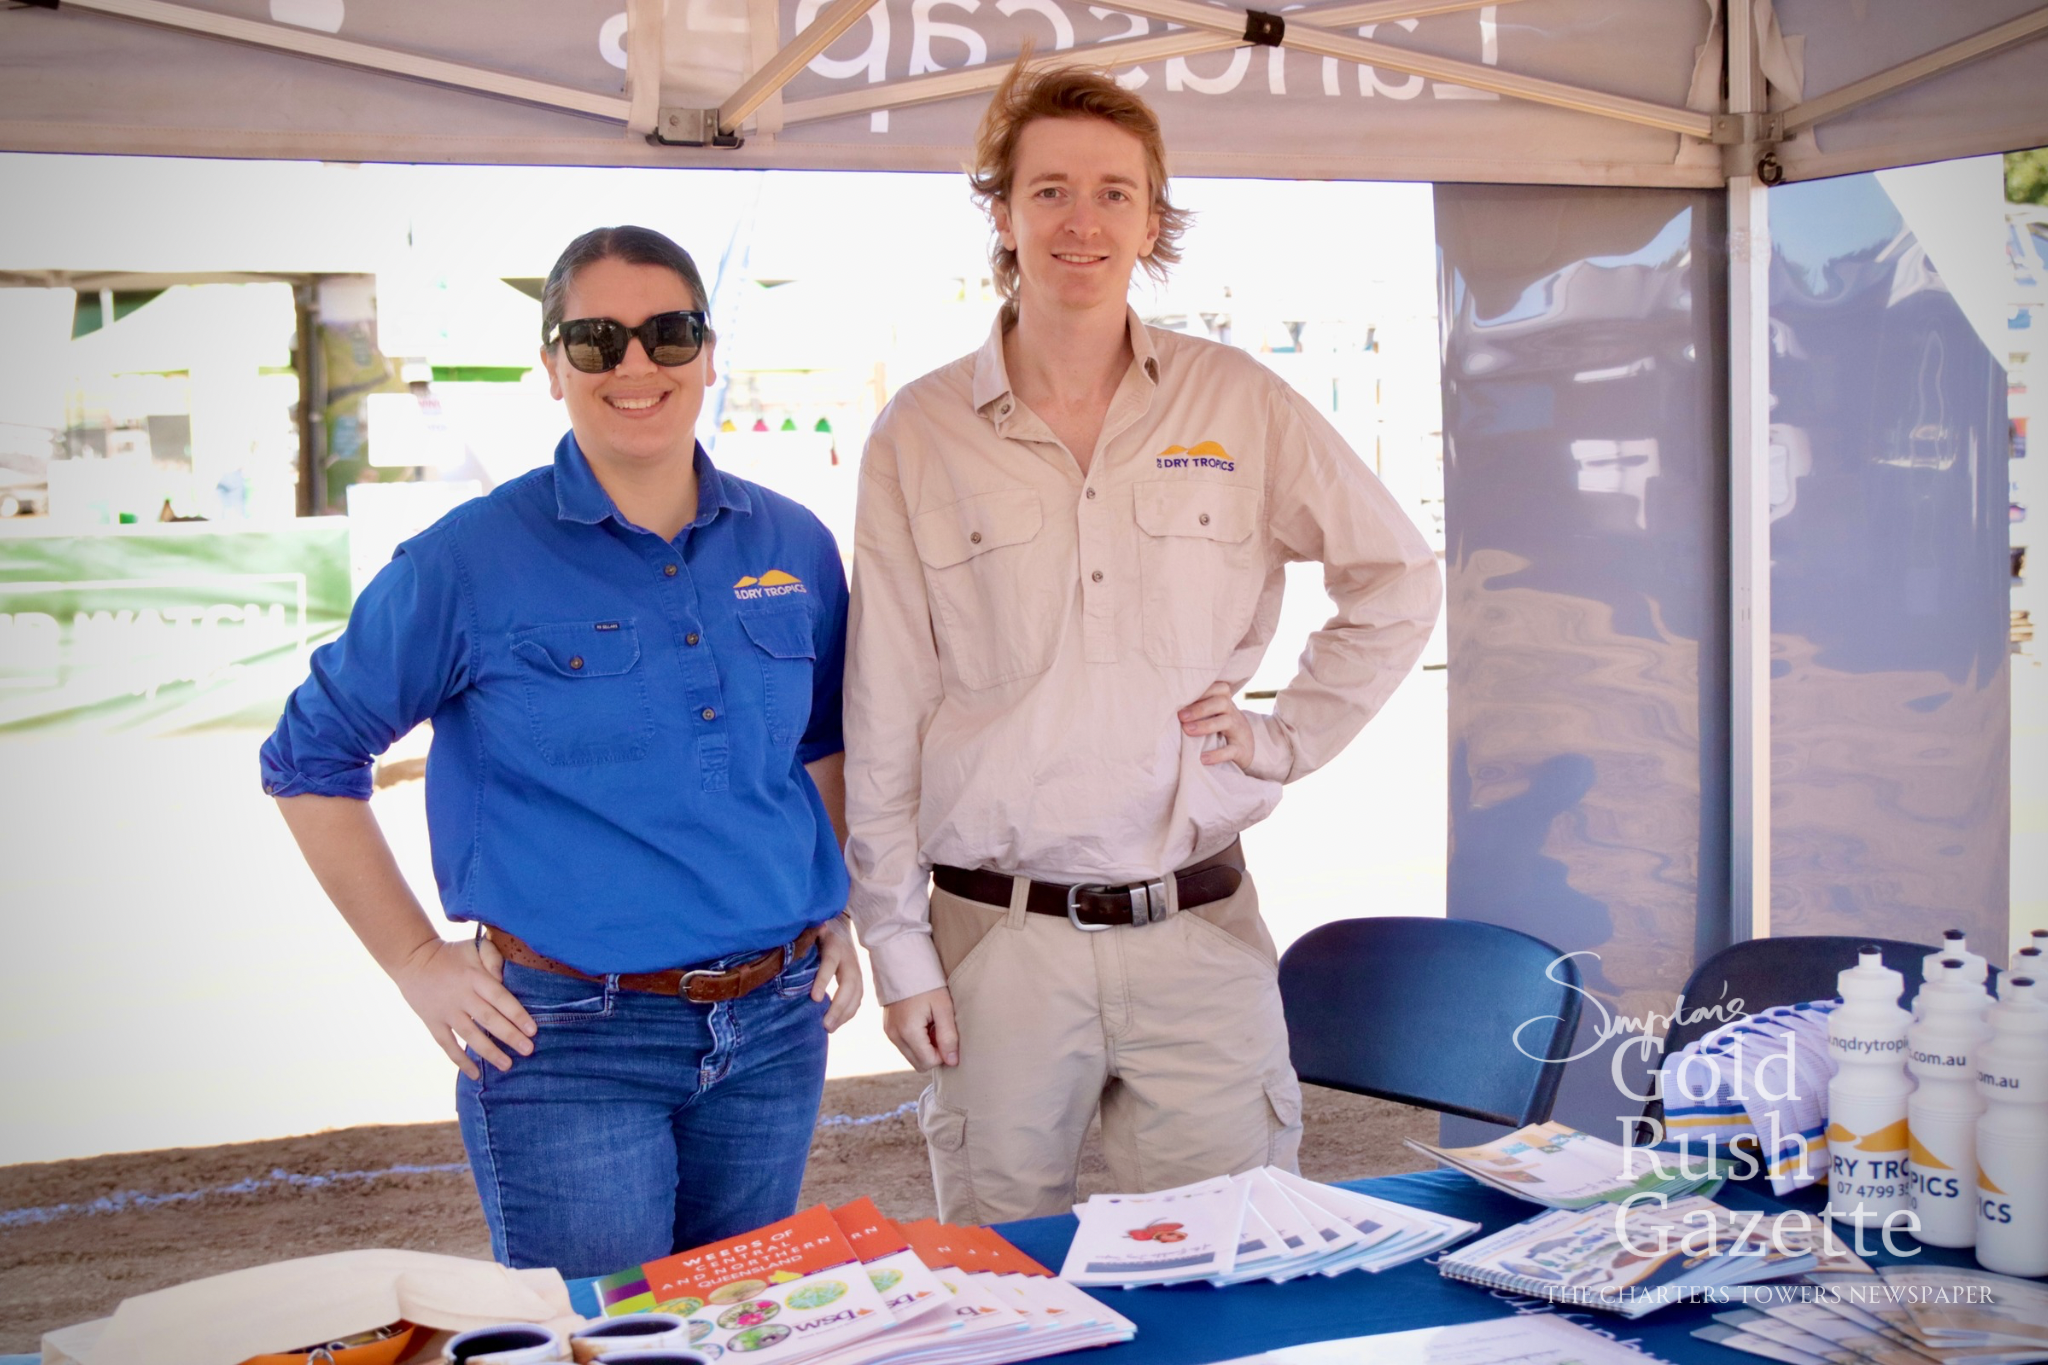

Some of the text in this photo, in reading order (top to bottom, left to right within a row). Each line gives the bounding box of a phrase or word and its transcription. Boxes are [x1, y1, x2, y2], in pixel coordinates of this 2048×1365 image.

[1164, 458, 1189, 468] DRY
[1192, 458, 1235, 472] TROPICS
[740, 588, 763, 600] DRY
[764, 584, 807, 597] TROPICS
[1837, 1181, 1853, 1195] 07
[1856, 1185, 1895, 1198] 4799
[661, 1274, 706, 1291] AND
[714, 1235, 831, 1275] NORTHERN
[682, 1229, 793, 1267] WEEDS OF
[696, 1241, 792, 1272] CENTRAL
[697, 1254, 803, 1289] QUEENSLAND
